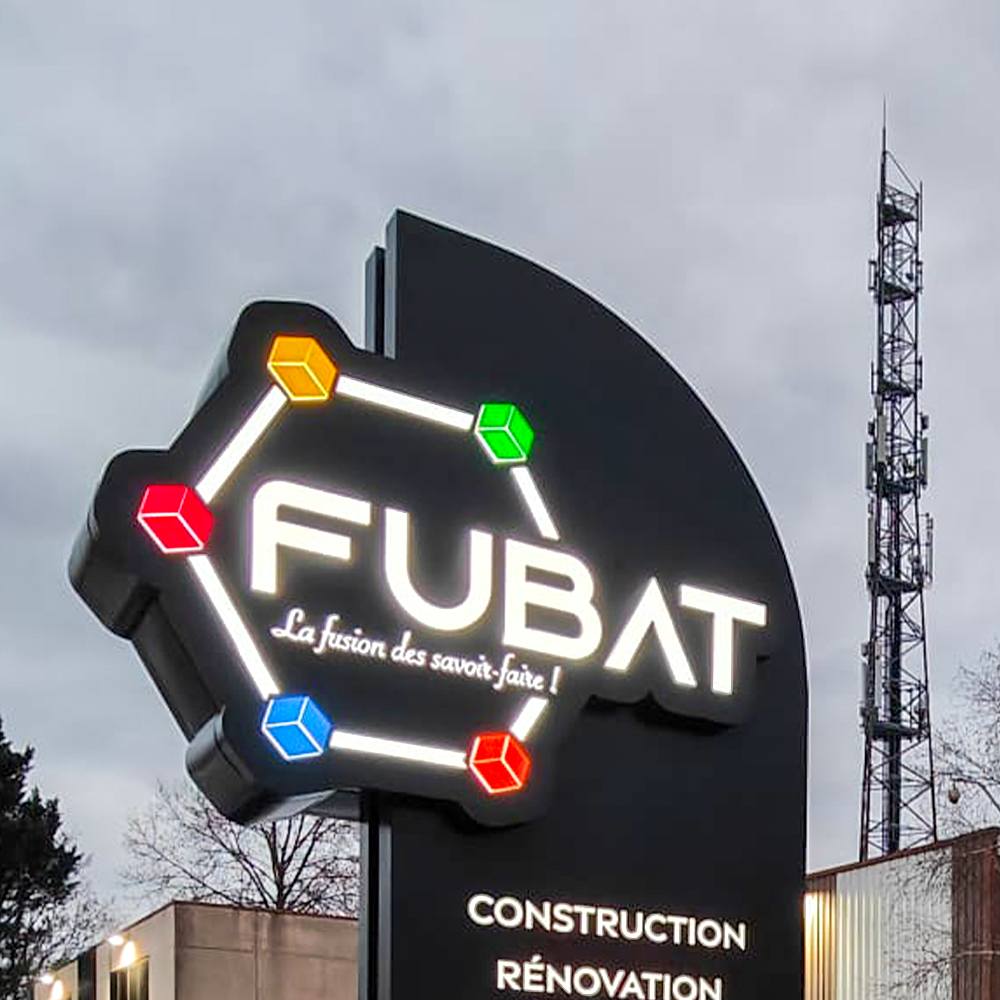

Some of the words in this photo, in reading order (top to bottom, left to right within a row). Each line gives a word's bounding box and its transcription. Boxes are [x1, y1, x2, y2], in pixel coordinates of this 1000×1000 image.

[250, 480, 767, 694] FUBAT
[271, 607, 315, 644] La
[313, 613, 387, 659] fusion
[391, 630, 427, 666] des
[467, 894, 747, 951] CONSTRUCTION
